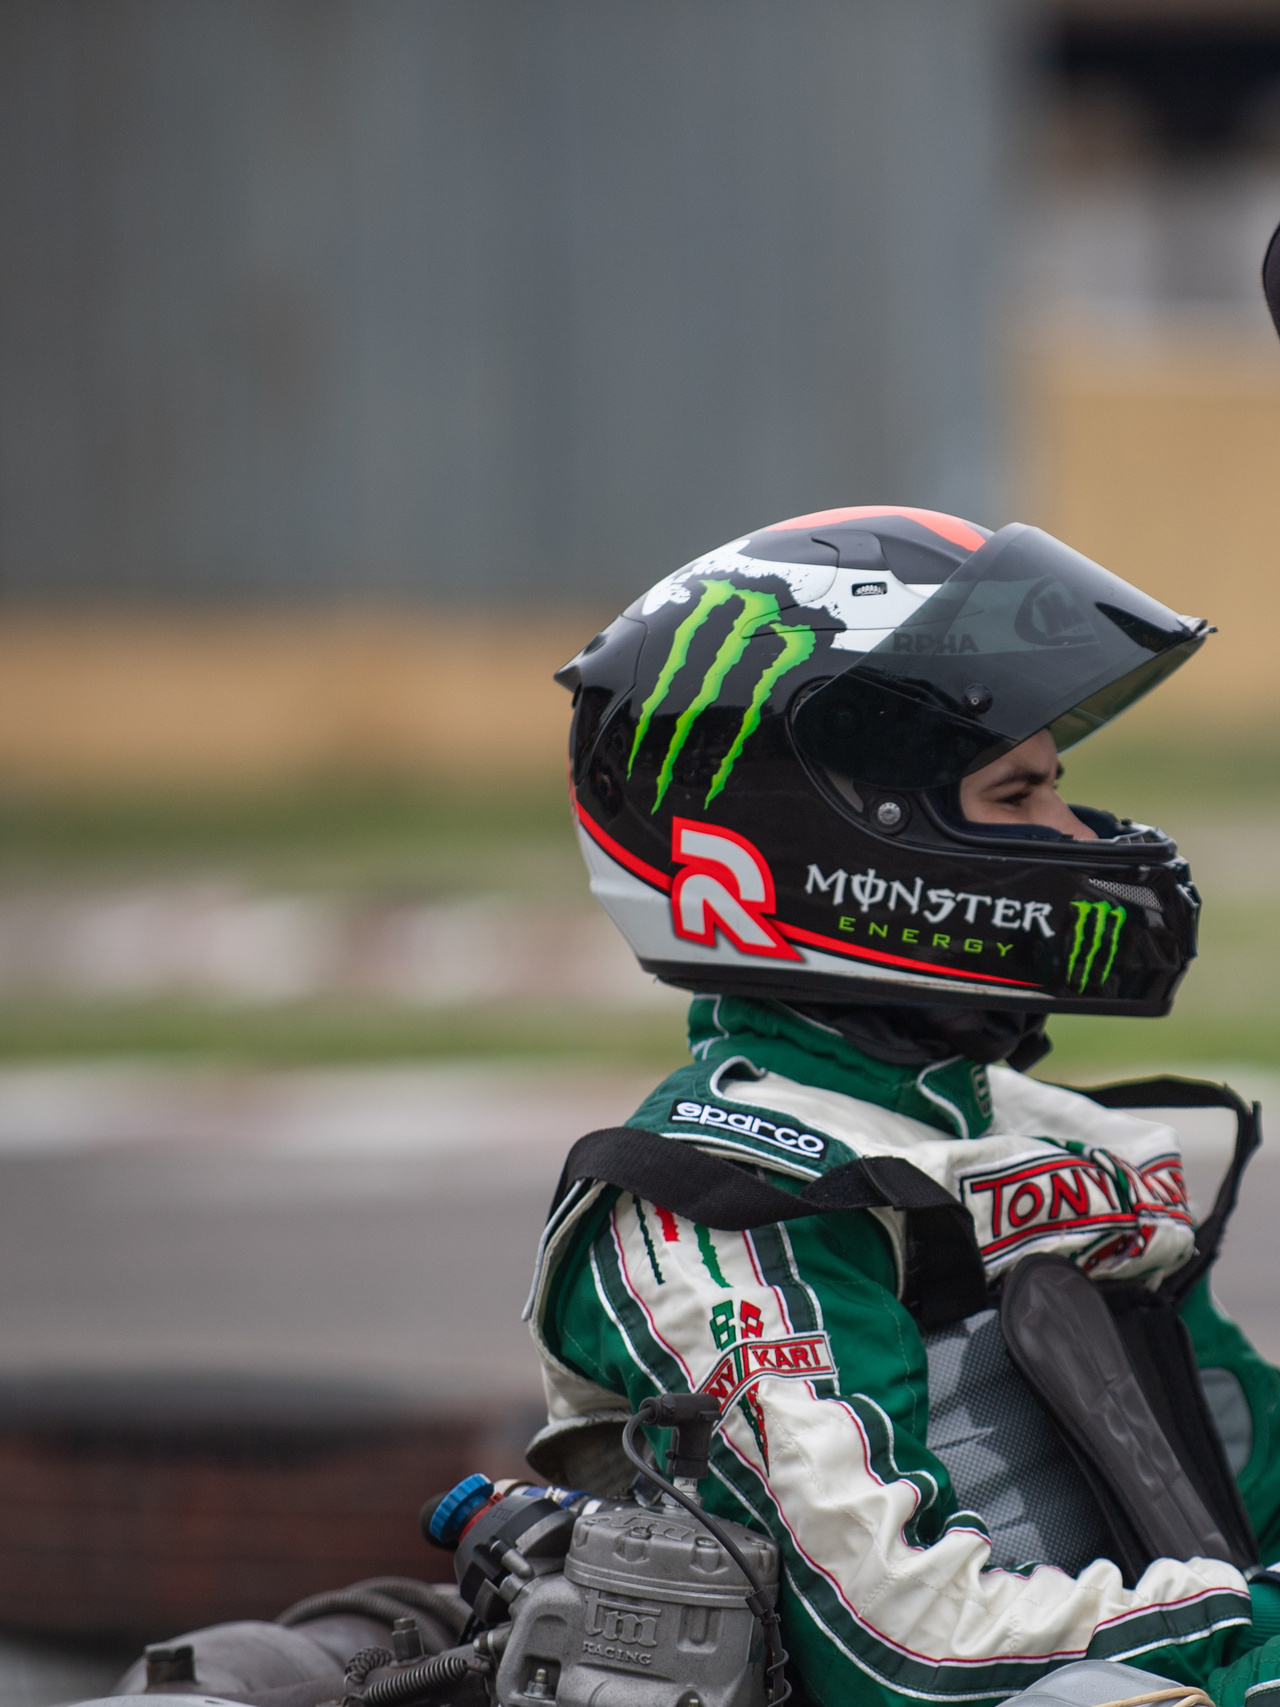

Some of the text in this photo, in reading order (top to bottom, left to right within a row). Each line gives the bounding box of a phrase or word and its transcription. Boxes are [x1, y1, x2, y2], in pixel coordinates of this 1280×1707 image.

[804, 863, 1056, 938] MONSTER
[837, 915, 1015, 957] ENERGY
[676, 1101, 825, 1153] sparco
[970, 1166, 1118, 1240] TONY
[752, 1340, 824, 1368] KART
[582, 1640, 652, 1666] RACING
